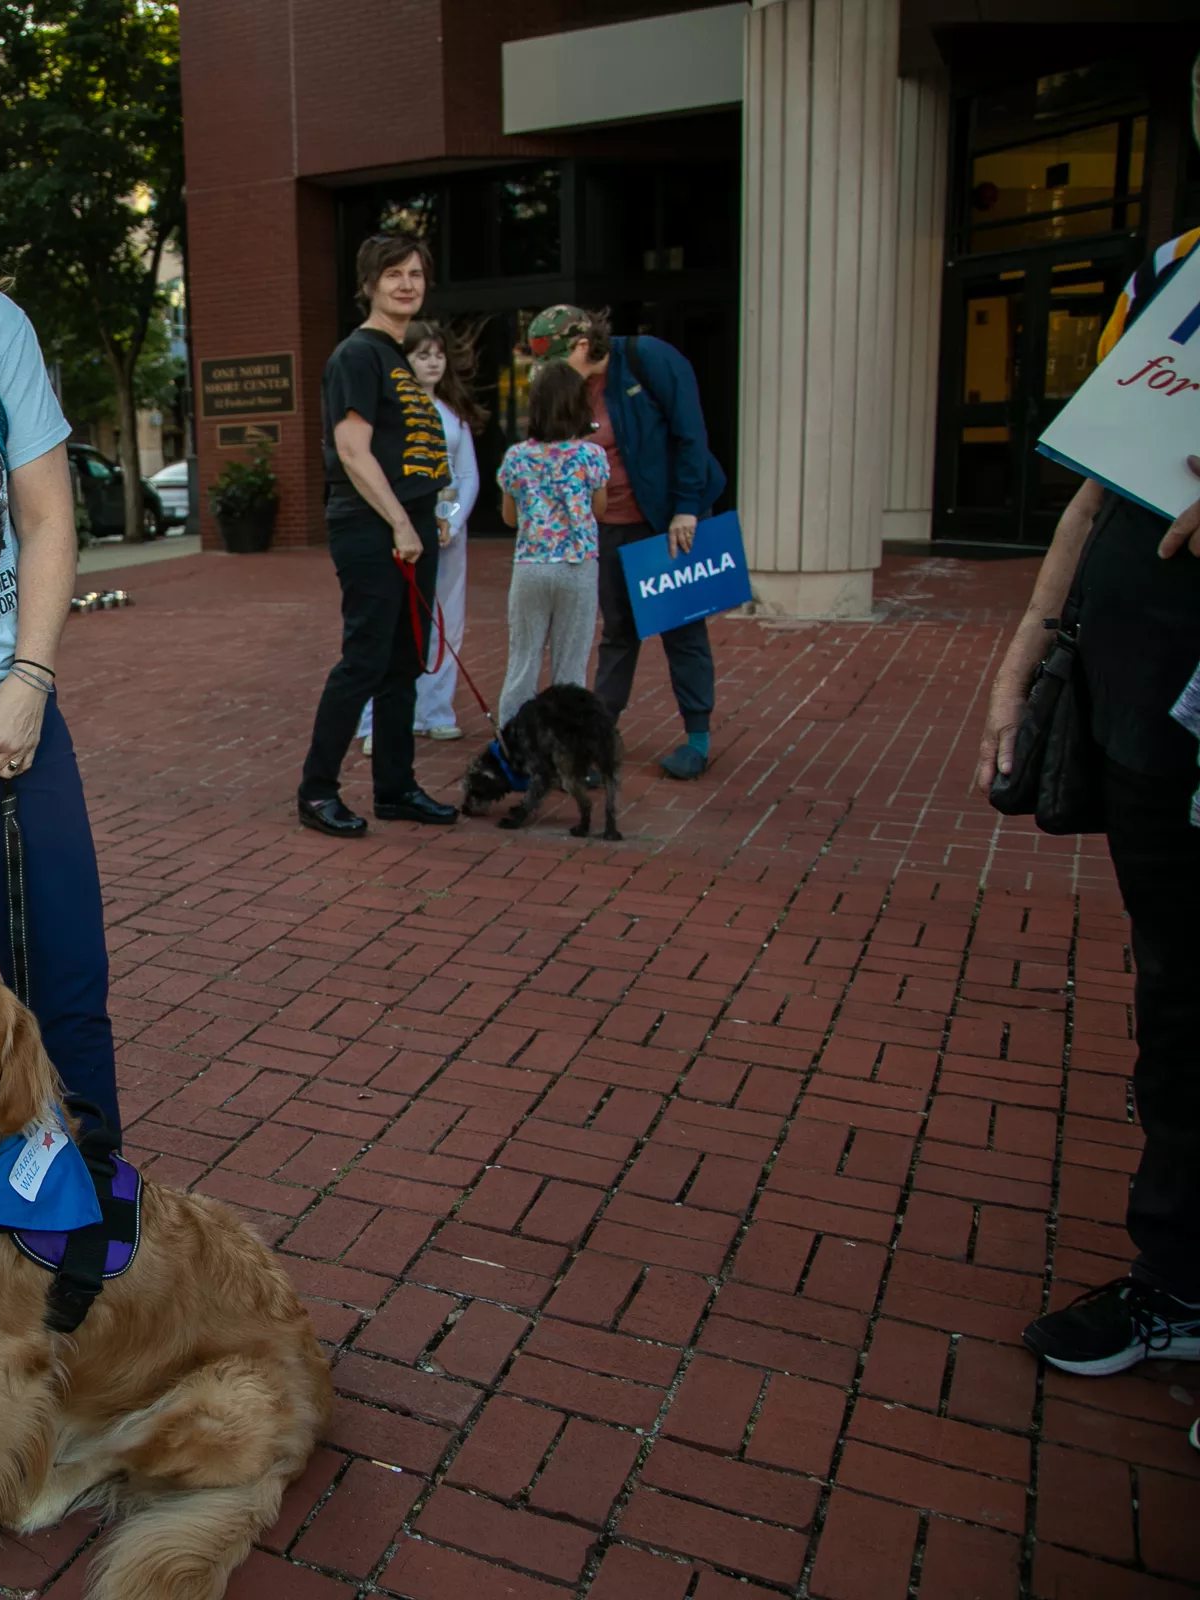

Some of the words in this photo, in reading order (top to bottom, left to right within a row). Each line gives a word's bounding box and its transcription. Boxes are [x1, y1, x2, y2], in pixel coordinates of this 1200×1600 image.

[1116, 356, 1200, 397] for
[639, 551, 736, 599] KAMALA
[13, 1141, 42, 1182] HARRIS
[20, 1159, 41, 1191] WALZ
